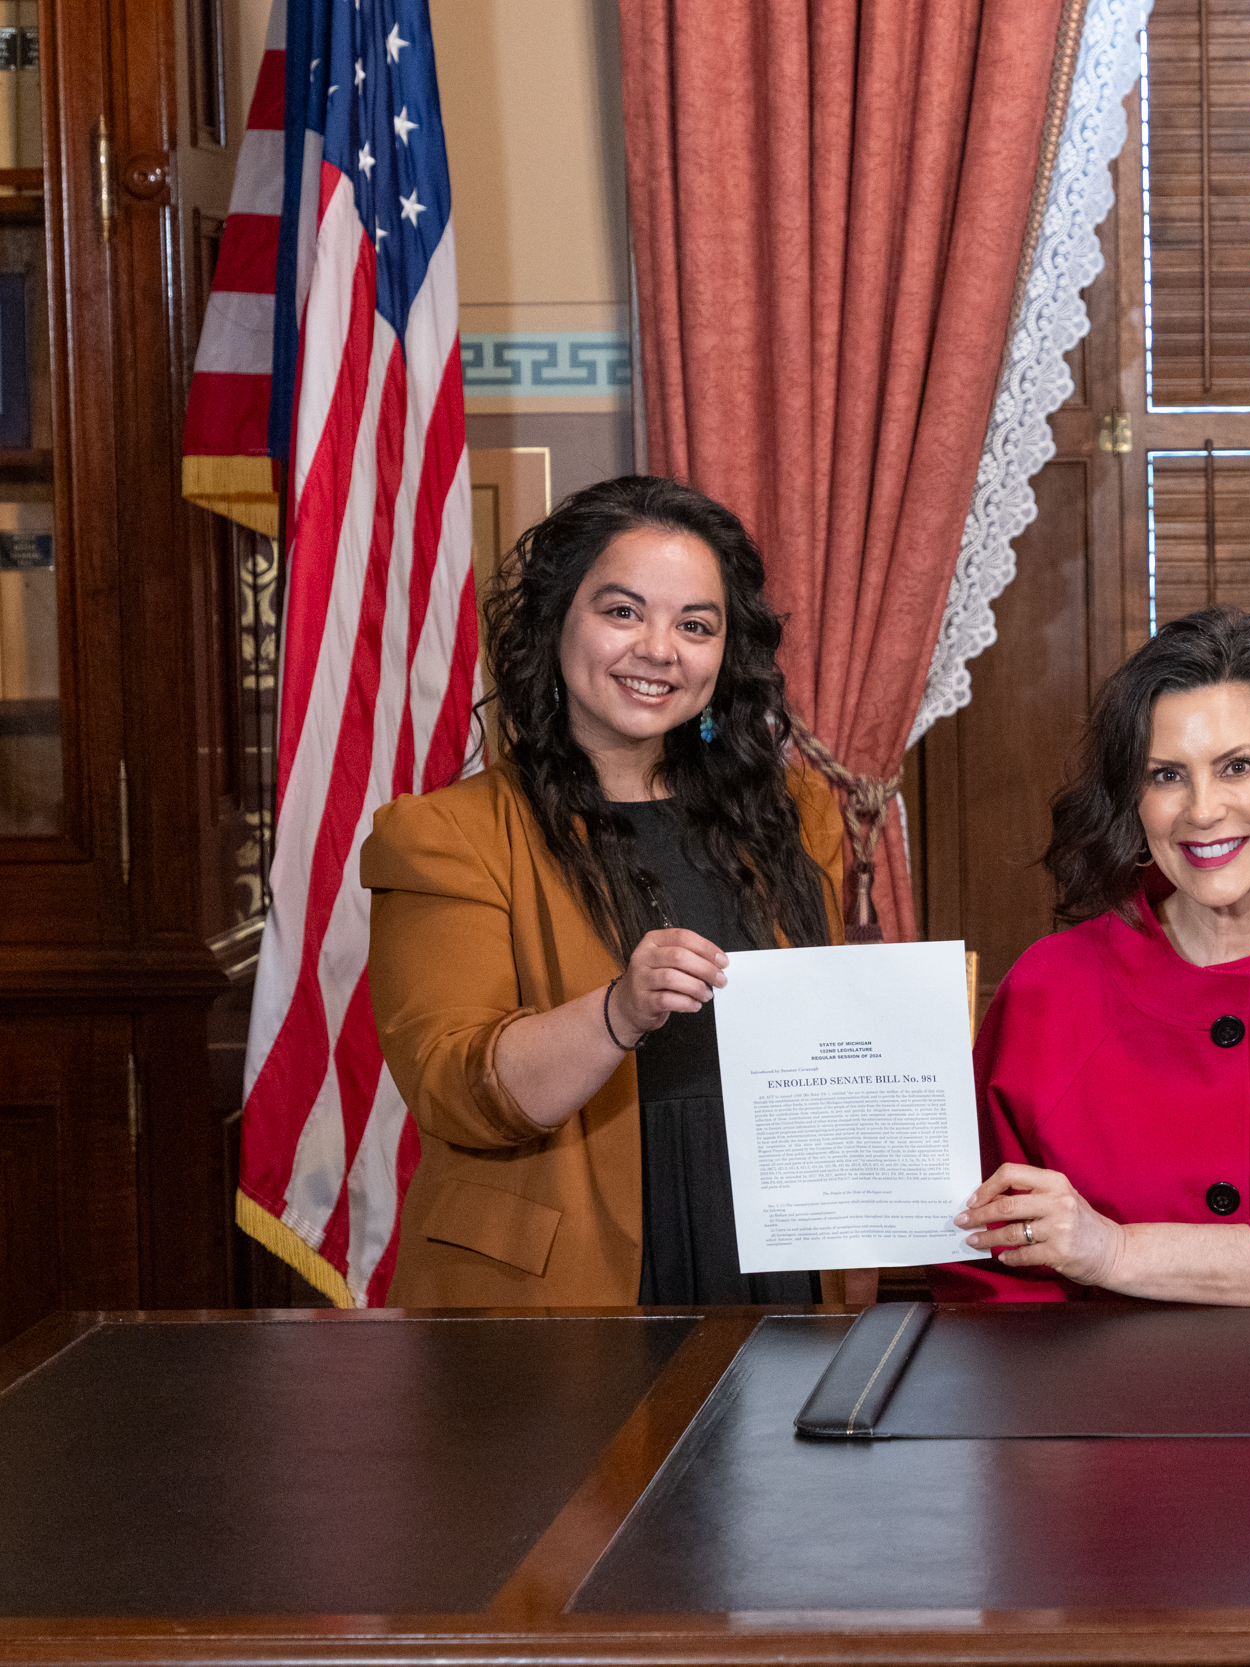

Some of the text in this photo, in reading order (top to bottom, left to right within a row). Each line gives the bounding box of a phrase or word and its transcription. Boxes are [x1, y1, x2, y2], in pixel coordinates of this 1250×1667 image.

[767, 1074, 937, 1089] ENROLLED SENATE BILL No. 981
